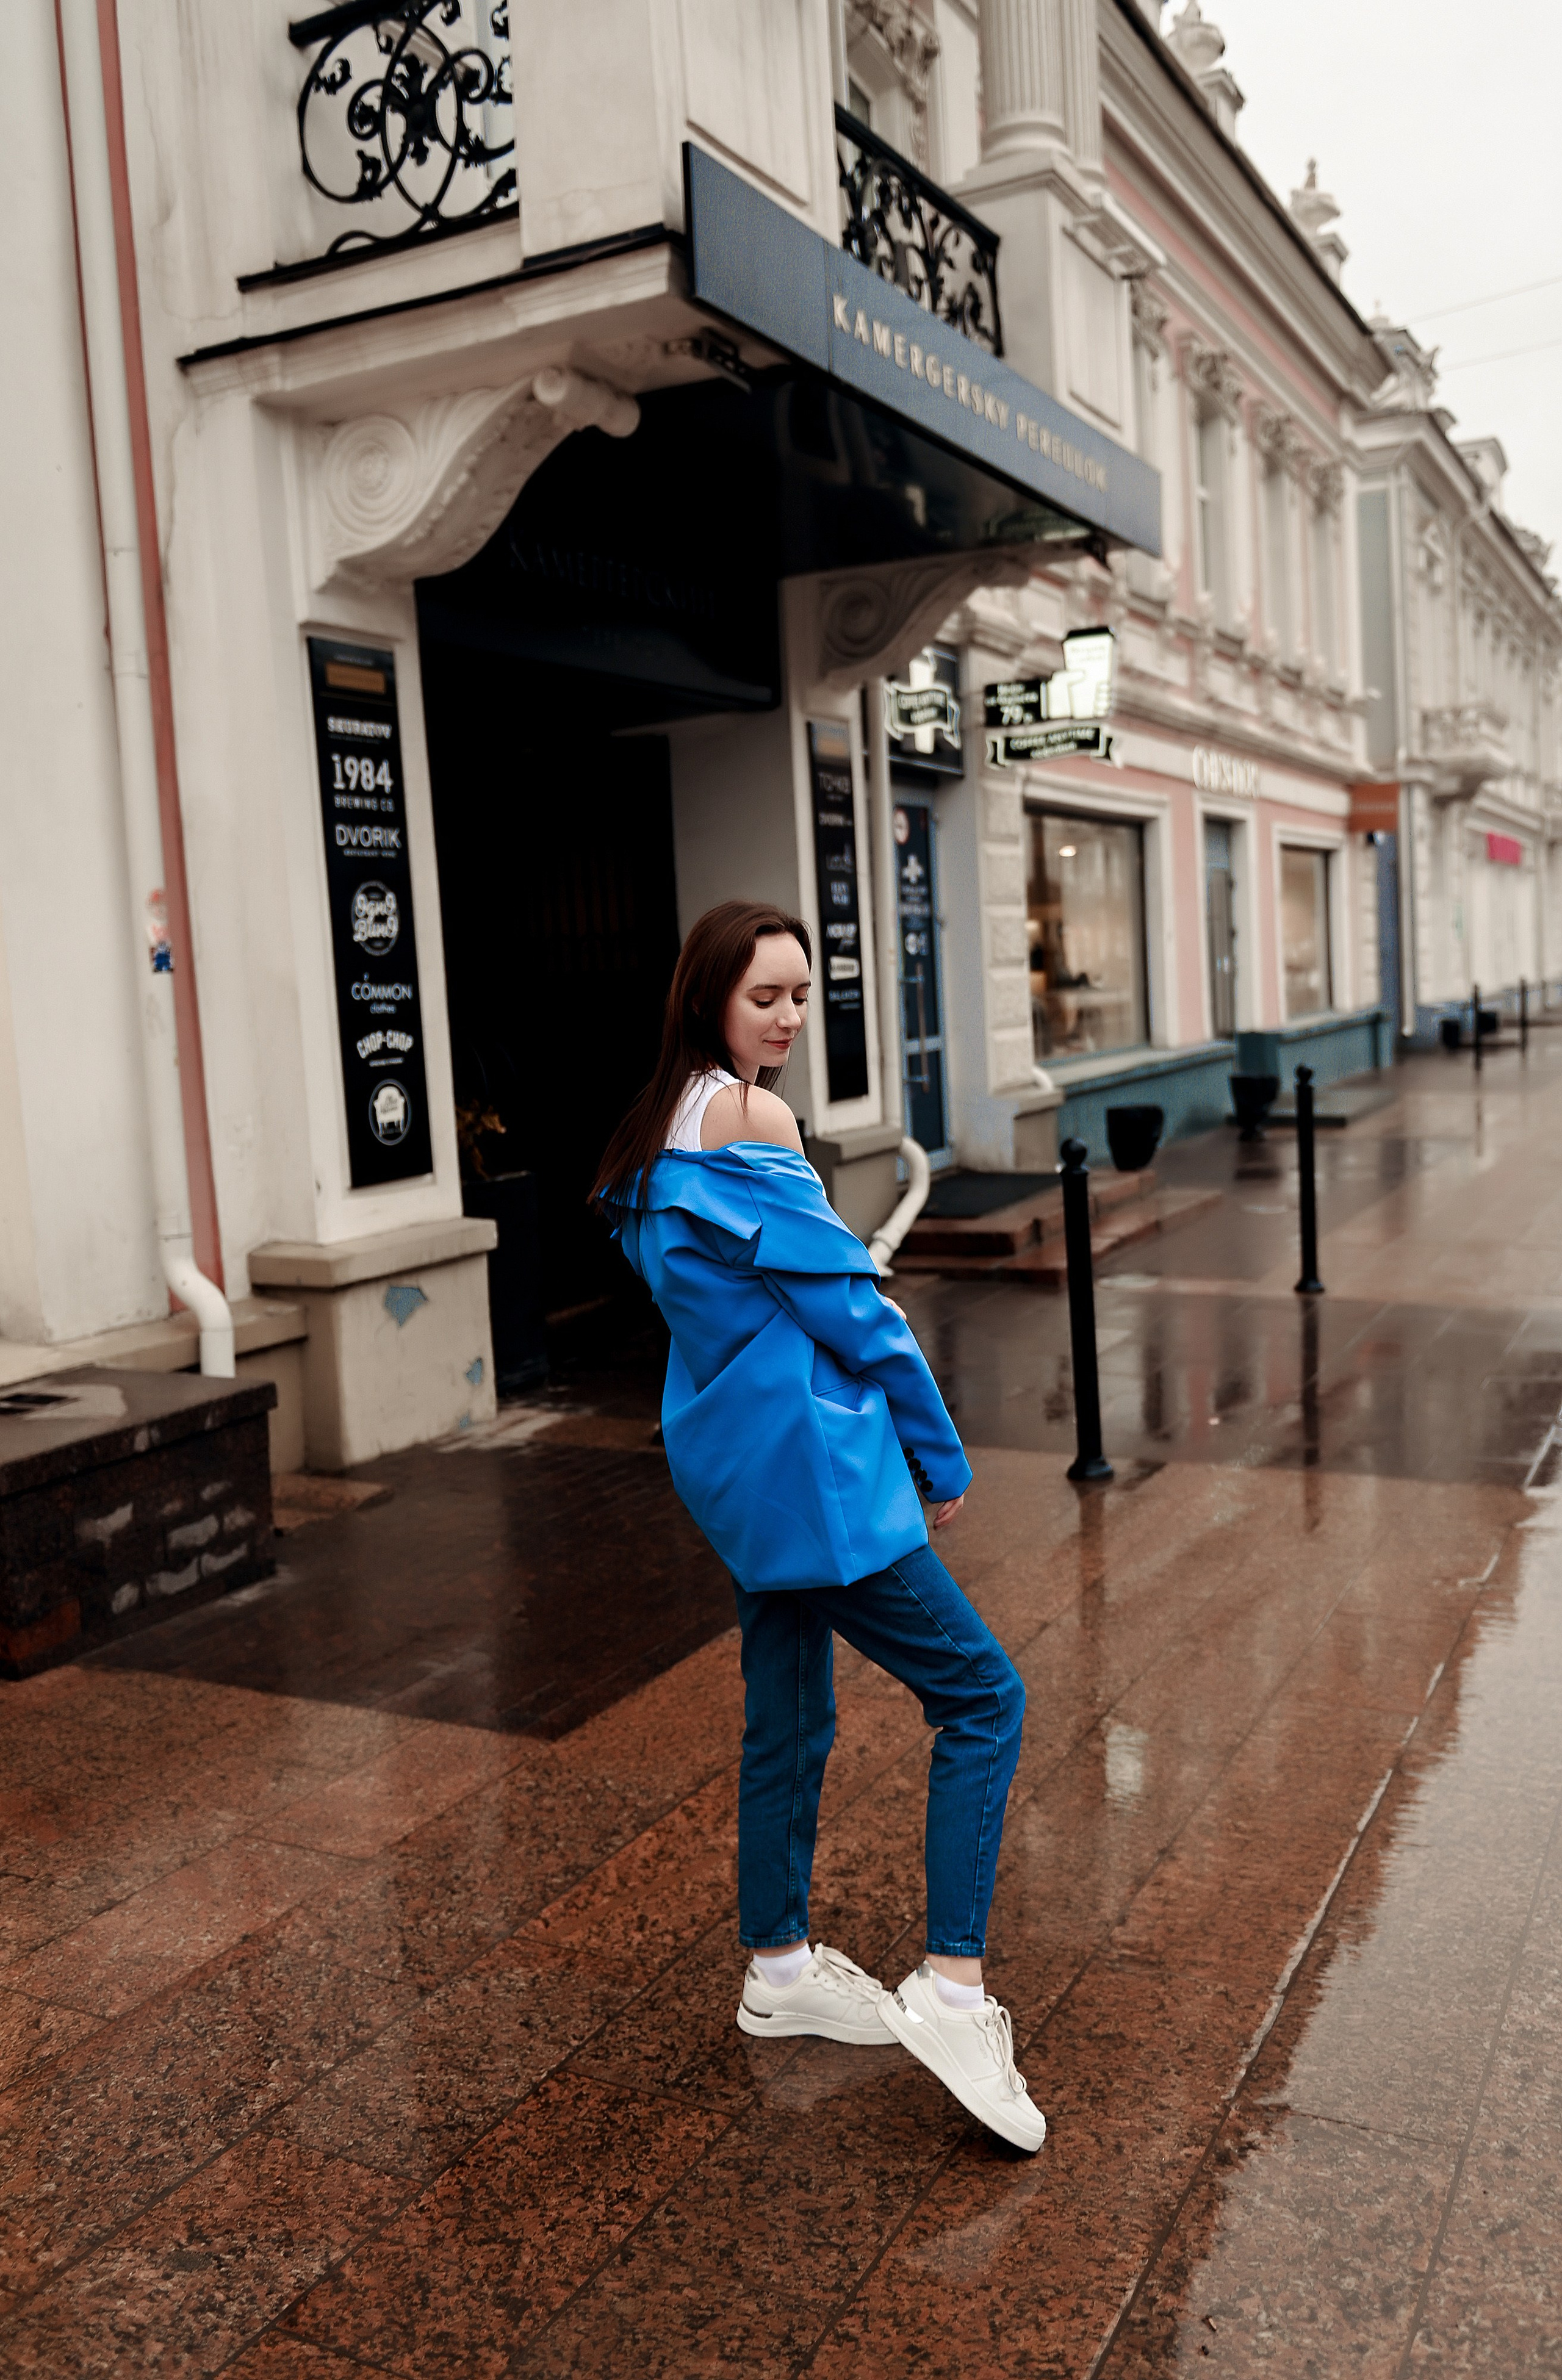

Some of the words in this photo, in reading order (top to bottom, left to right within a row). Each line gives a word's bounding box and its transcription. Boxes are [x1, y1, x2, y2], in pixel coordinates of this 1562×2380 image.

[833, 293, 1009, 431] KAMERGERSKY
[1016, 412, 1107, 493] PEREULOK
[331, 753, 394, 794] 1984
[334, 795, 378, 811] BREWING
[336, 824, 401, 849] DVORIK
